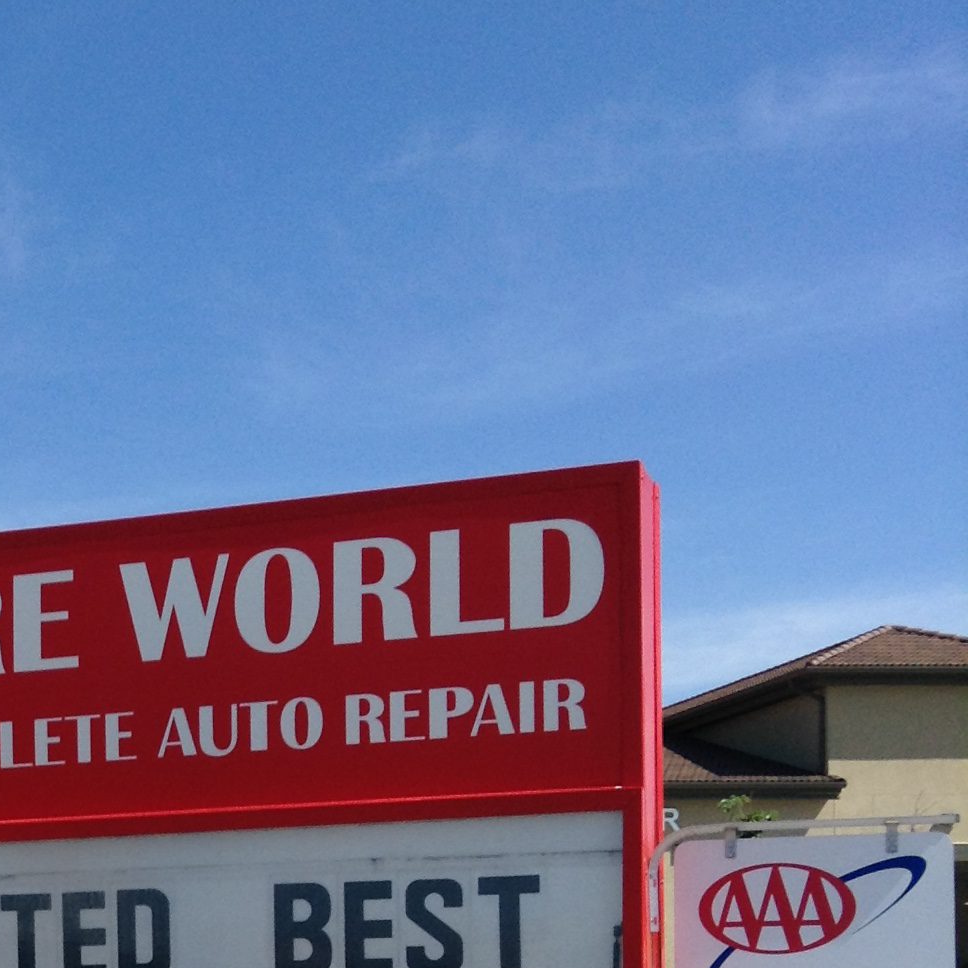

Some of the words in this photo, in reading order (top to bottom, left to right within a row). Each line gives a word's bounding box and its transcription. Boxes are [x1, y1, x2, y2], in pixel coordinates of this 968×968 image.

[119, 516, 605, 662] WORLD
[158, 697, 323, 758] AUTO
[345, 679, 587, 745] REPAIR
[713, 864, 842, 952] AAA
